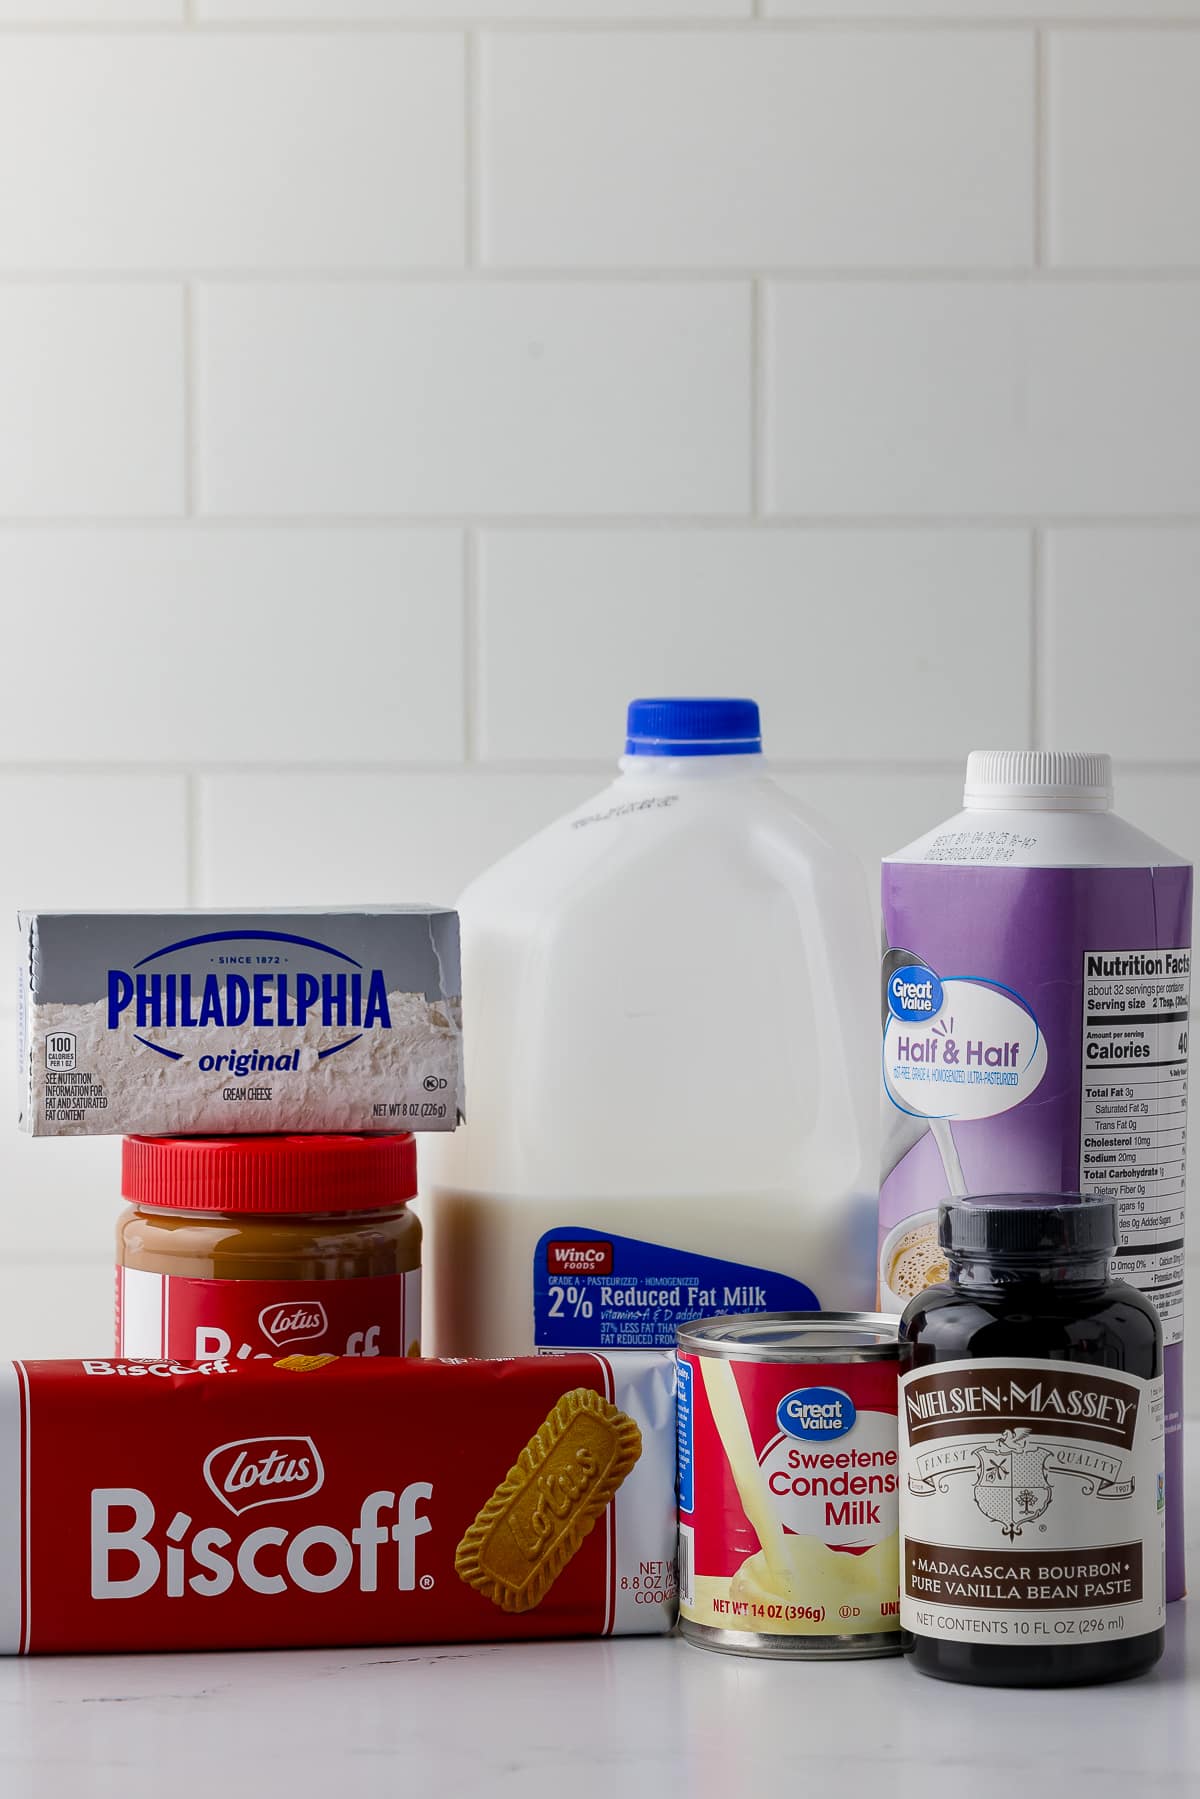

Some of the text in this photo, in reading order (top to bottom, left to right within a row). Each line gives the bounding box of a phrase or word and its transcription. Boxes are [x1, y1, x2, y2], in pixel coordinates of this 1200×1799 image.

[218, 956, 281, 964] SINCE 1872
[1087, 953, 1190, 977] Nutrition Facts
[892, 977, 933, 999] Great
[1087, 984, 1113, 996] about
[1113, 984, 1124, 995] 32
[1125, 983, 1156, 997] servings
[1156, 984, 1166, 995] per
[107, 969, 392, 1030] PHILADELPHIA
[900, 996, 932, 1011] Value
[1087, 998, 1126, 1012] Serving
[1128, 998, 1146, 1010] size
[1152, 999, 1158, 1009] 2
[1086, 1030, 1145, 1040] Amount per serving
[50, 1037, 71, 1052] 100
[1086, 1032, 1188, 1060] Calories 40
[897, 1036, 1020, 1068] Half & Half
[198, 1048, 300, 1077] original
[45, 1072, 92, 1085] SEE NUTRITION
[45, 1085, 103, 1097] INFORMATION FOR
[222, 1088, 273, 1101] CREAM CHEESE
[1085, 1087, 1134, 1098] Total Fat 3g
[45, 1098, 108, 1109] FAT AND SATURATED
[373, 1103, 447, 1118] NET WT 8 OZ (226g)
[1095, 1103, 1149, 1114] Saturated Fat 2g
[45, 1109, 86, 1121] FAT CONTENT
[1095, 1120, 1137, 1131] Trans Fat 0g
[1084, 1136, 1151, 1149] Cholesterol 10mg
[1084, 1152, 1137, 1164] Sodium 20mg
[1083, 1170, 1107, 1180] Total
[1108, 1167, 1158, 1180] Carbohydrate
[1094, 1184, 1146, 1197] Dietary Fiber 0g
[1137, 1201, 1145, 1212] 1g
[1131, 1218, 1140, 1229] 0g
[1141, 1217, 1159, 1228] Added
[1121, 1234, 1129, 1245] 1g
[554, 1248, 605, 1262] WinCo
[564, 1261, 596, 1270] FOODS
[1117, 1260, 1135, 1272] 0mcg
[1135, 1260, 1147, 1270] 0%
[548, 1276, 700, 1287] GRADE A PASTEURIZED HOMOGENIZED
[547, 1286, 594, 1319] 2%
[600, 1286, 767, 1307] Reduced Fat Milk
[270, 1308, 321, 1334] Lotus
[600, 1308, 640, 1321] vitamins
[663, 1308, 673, 1321] D
[675, 1307, 704, 1320] added
[600, 1322, 618, 1333] 37%
[620, 1322, 640, 1333] LESS
[641, 1322, 656, 1333] FAT
[600, 1334, 615, 1345] FAT
[616, 1334, 653, 1345] REDUCED
[786, 1399, 843, 1420] Great
[799, 1416, 843, 1431] Value
[787, 1449, 897, 1469] Sweetene
[924, 1448, 1118, 1475] FINEST QUALITY
[223, 1448, 311, 1493] Lotus
[768, 1472, 899, 1496] Condens
[1115, 1485, 1130, 1494] 1907
[824, 1501, 881, 1526] Milk
[91, 1482, 434, 1600] Biscoff
[639, 1561, 664, 1575] NET
[917, 1557, 1122, 1580] MADAGASCAR BOURBON
[620, 1576, 641, 1590] 8.8
[643, 1575, 662, 1590] OZ
[911, 1575, 942, 1594] PURE
[944, 1582, 1021, 1600] VANILLA
[1026, 1584, 1078, 1600] BEAN
[1084, 1578, 1132, 1597] PASTE
[713, 1599, 730, 1614] NET
[732, 1600, 749, 1616] WT
[751, 1603, 765, 1618] 14
[767, 1605, 783, 1619] OZ
[785, 1605, 826, 1622] (396g)
[916, 1611, 1125, 1636] NET CONTENTS 10 FL OZ (296 ml)
